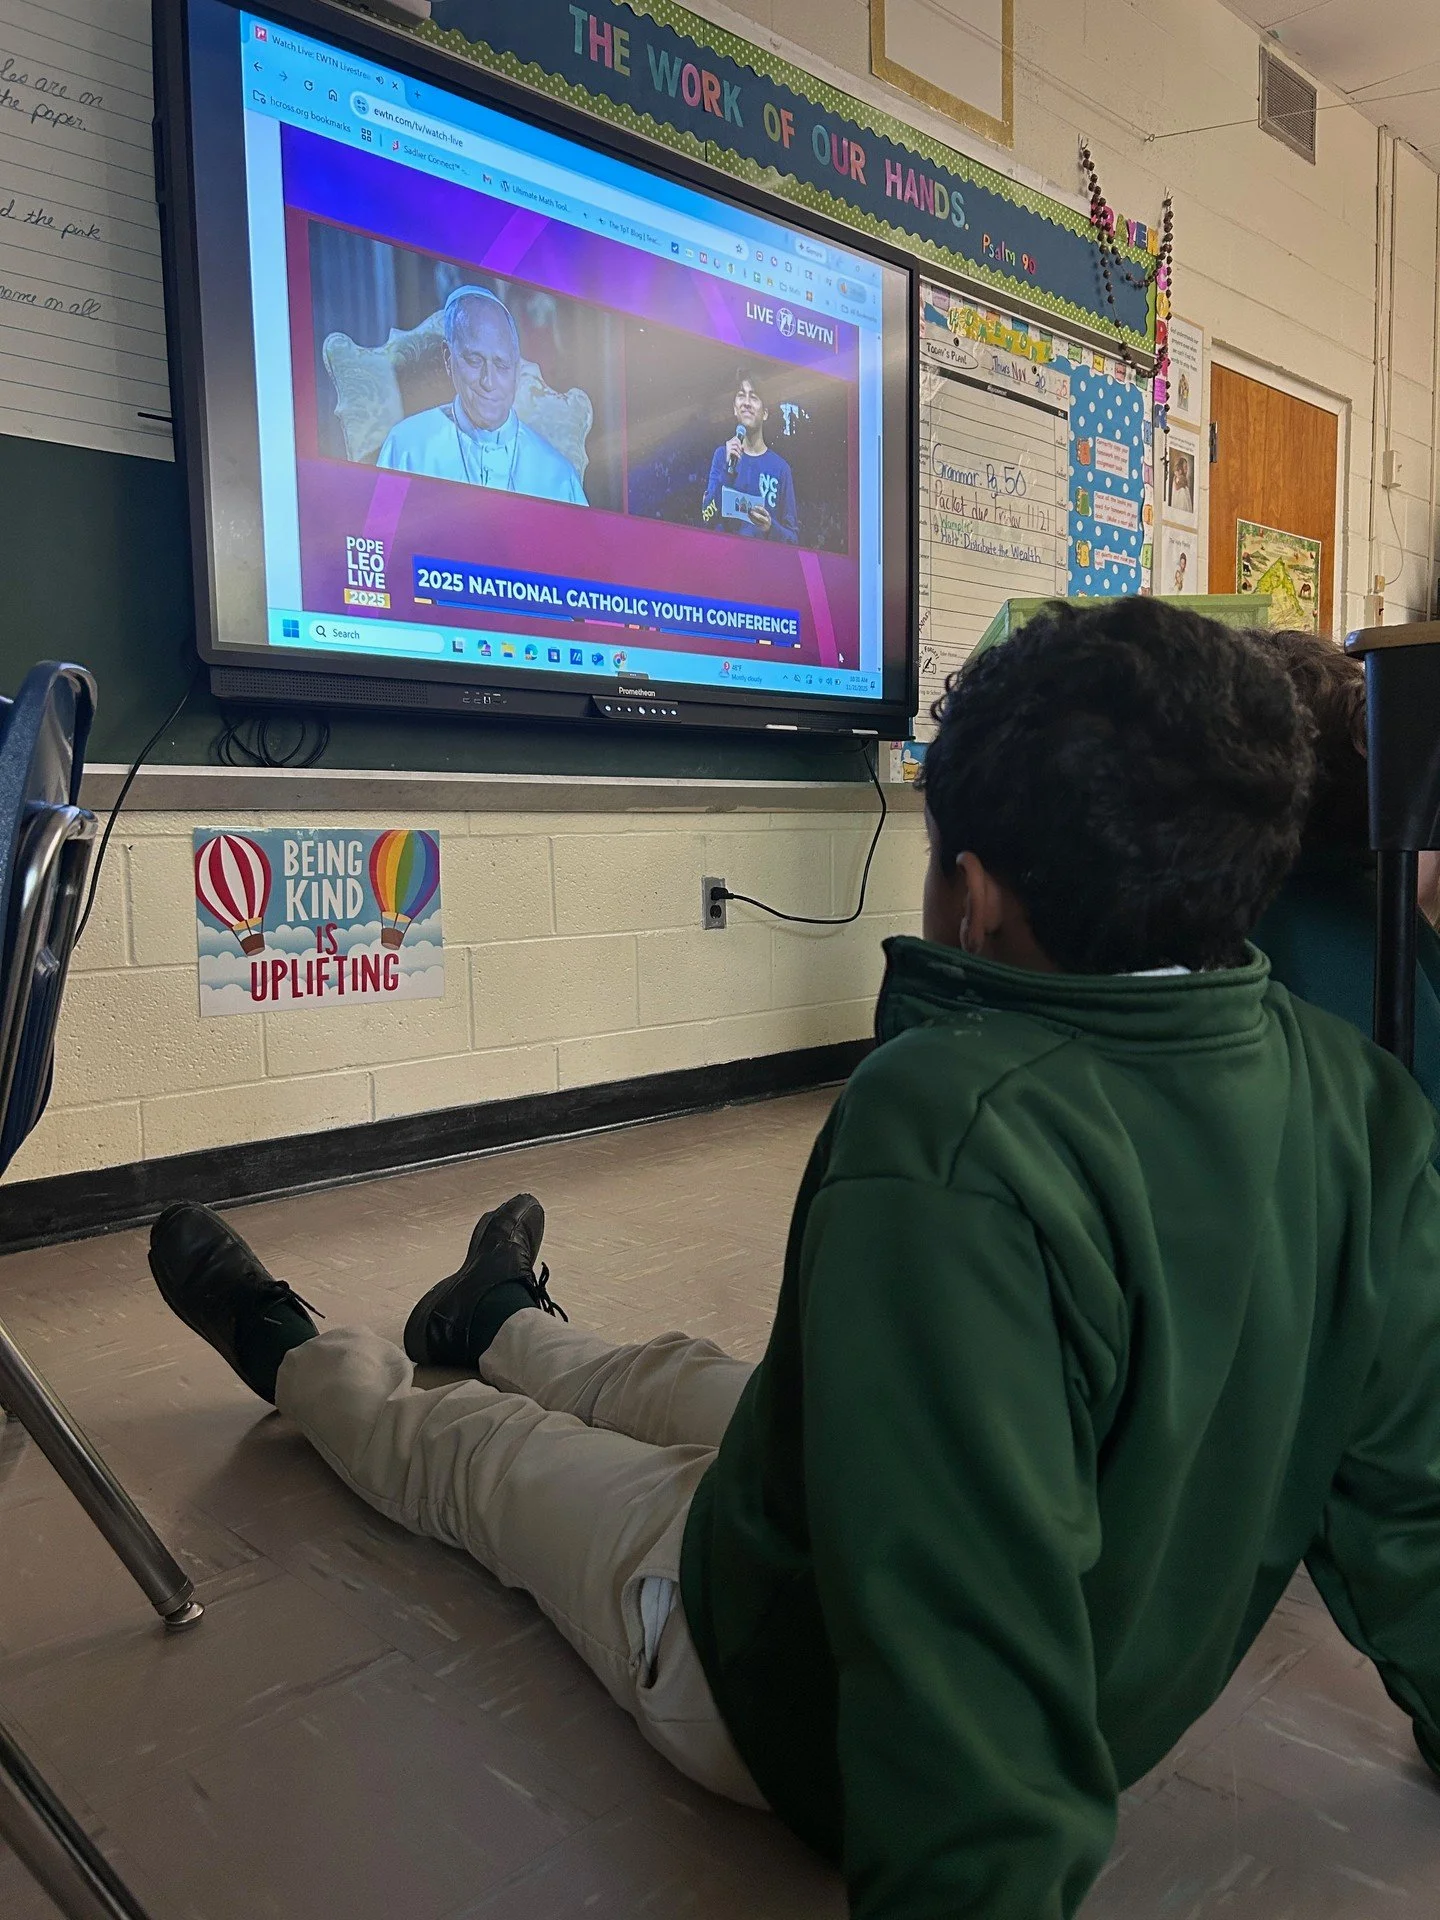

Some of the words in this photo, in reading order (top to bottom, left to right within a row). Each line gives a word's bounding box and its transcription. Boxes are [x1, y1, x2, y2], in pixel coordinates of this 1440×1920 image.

[272, 34, 296, 52] Watch
[297, 45, 315, 58] Live:
[316, 52, 339, 68] EWTN
[35, 77, 70, 100] are
[79, 92, 104, 107] on
[31, 103, 87, 132] paper.
[270, 97, 309, 119] hcross.org
[311, 110, 351, 132] bookmarks
[374, 107, 464, 148] ewtn.com/tv/watch-live
[568, 4, 631, 77] THE
[647, 44, 744, 128] WORK
[763, 102, 795, 149] OF
[812, 124, 867, 185] OUR
[884, 158, 970, 231] HANDS.
[24, 208, 56, 229] the
[61, 219, 101, 239] pink
[981, 233, 1016, 266] Psalm
[1021, 253, 1037, 275] 90
[44, 297, 64, 310] on
[69, 298, 102, 316] all
[746, 301, 773, 325] LIVE
[796, 319, 833, 345] EWTN
[926, 342, 951, 359] TODAY'S
[1003, 466, 1027, 496] 50
[935, 479, 968, 516] Packet
[972, 491, 989, 520] due
[346, 536, 384, 555] POPE
[347, 550, 385, 572] LEO
[964, 532, 997, 556] Distribute
[1011, 544, 1041, 564] Wealth
[347, 569, 386, 590] LIVE
[349, 590, 386, 606] 2025
[417, 568, 465, 592] 2025
[468, 576, 563, 606] NATIONAL
[566, 589, 649, 617] CATHOLIC
[651, 600, 703, 623] YOUTH
[706, 608, 798, 636] CONFERENCE
[333, 627, 360, 641] Search
[618, 686, 656, 697] Promethean
[283, 839, 363, 877] BEING
[286, 878, 364, 922] KIND
[316, 922, 338, 955] IS
[251, 953, 400, 1002] UPLIFTING
